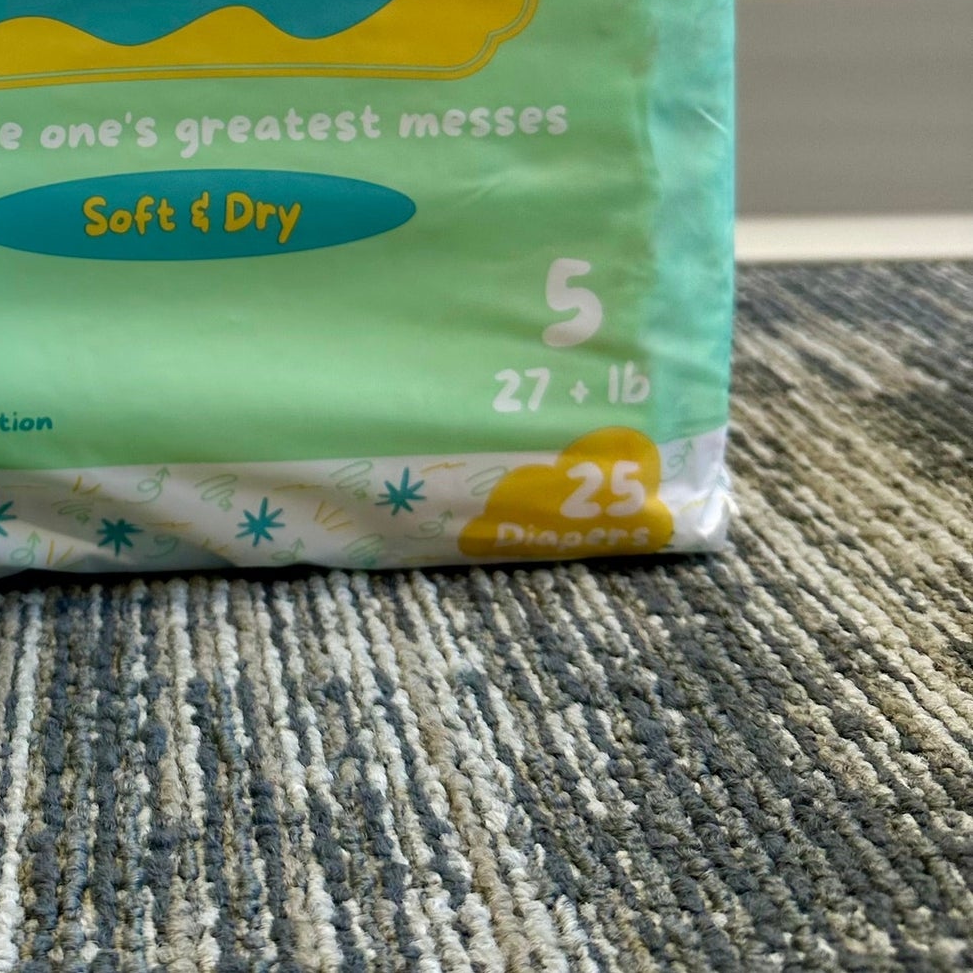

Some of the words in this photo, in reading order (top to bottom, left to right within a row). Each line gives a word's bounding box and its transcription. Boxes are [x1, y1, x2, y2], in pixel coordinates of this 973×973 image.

[40, 111, 158, 149] one's
[175, 105, 382, 159] greatest
[398, 105, 568, 138] messes
[82, 195, 176, 238] Soft
[190, 191, 210, 233] &
[223, 191, 302, 245] Dry
[541, 257, 603, 347] 5
[491, 367, 551, 413] 27
[559, 460, 646, 518] 25
[494, 522, 651, 551] Diapers
